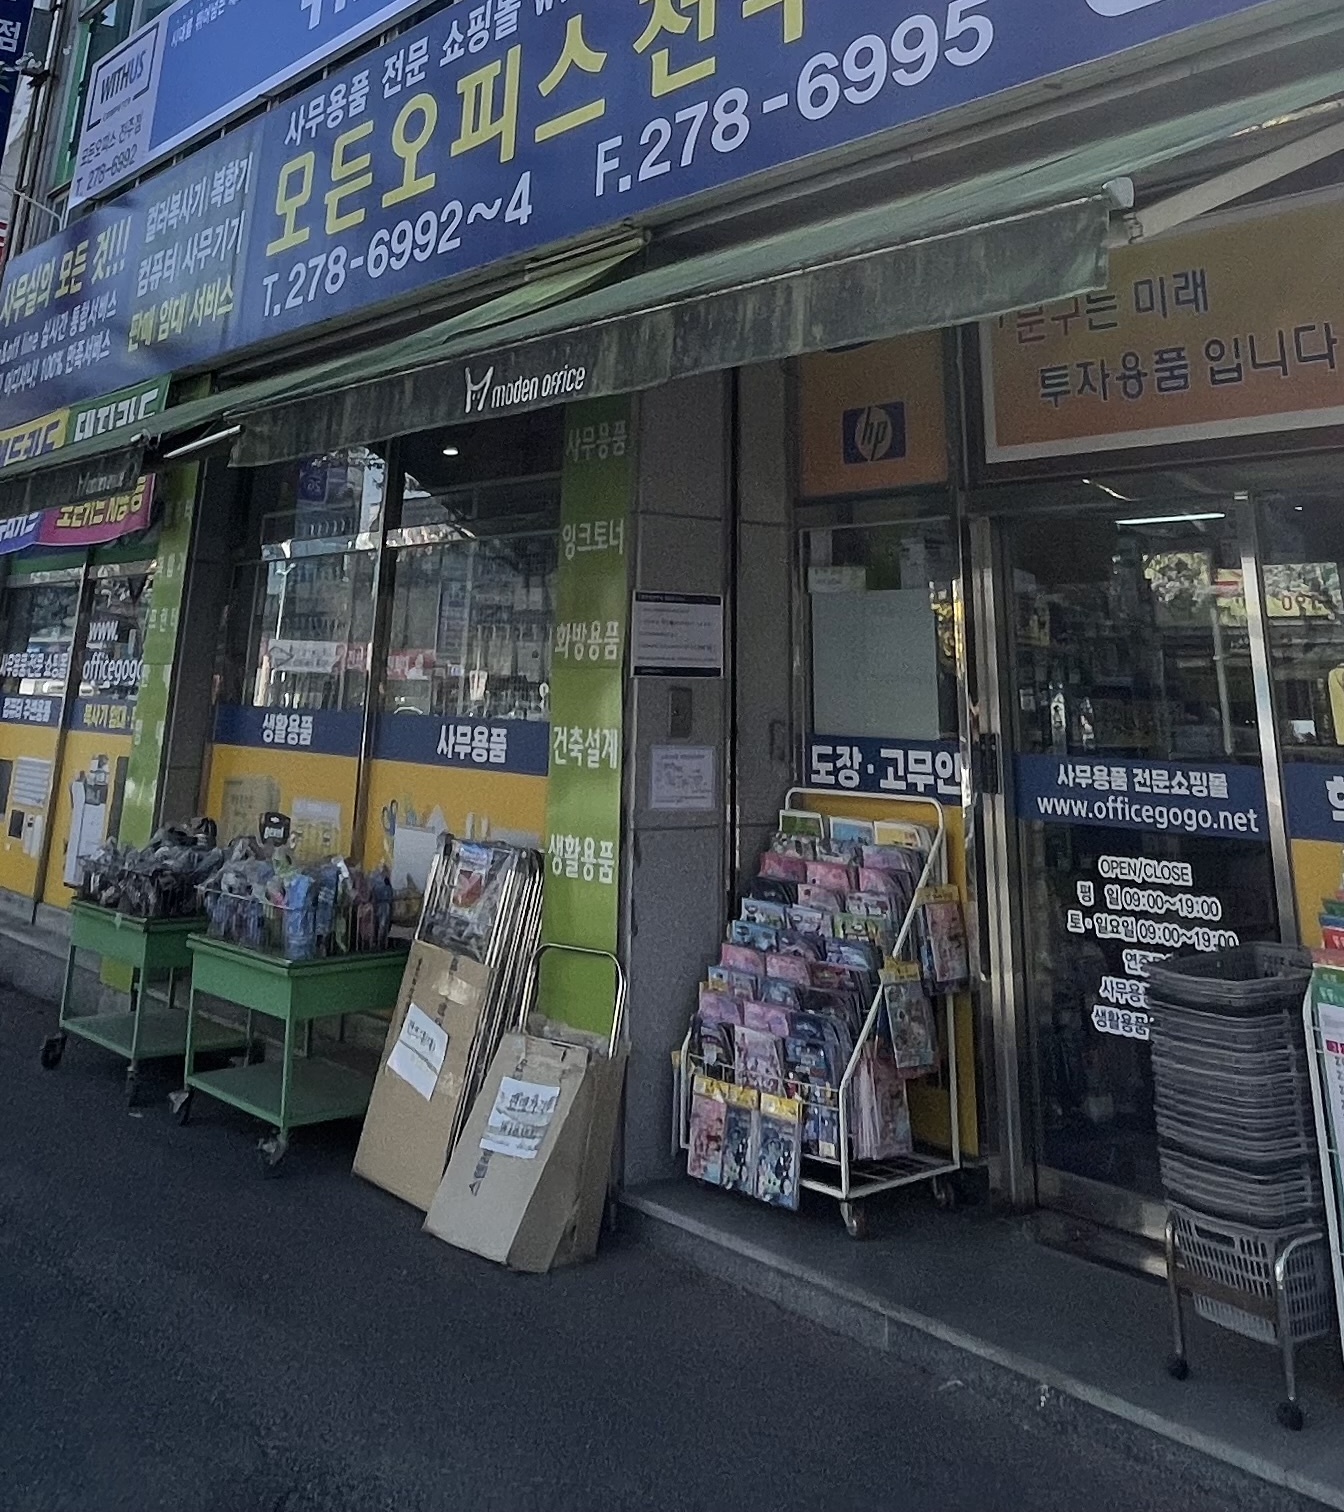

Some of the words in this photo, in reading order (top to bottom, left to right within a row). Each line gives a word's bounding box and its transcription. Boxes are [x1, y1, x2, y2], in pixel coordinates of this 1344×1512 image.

[99, 49, 147, 105] WITHUS
[282, 68, 374, 149] 사무용품
[380, 34, 430, 102] 전문
[210, 151, 254, 209] 복합기
[136, 241, 179, 298] 컴퓨터
[181, 209, 247, 275] 사무기기
[0, 256, 56, 328] 사무실의
[54, 239, 89, 299] 모든
[188, 274, 235, 328] 서비스
[1132, 267, 1209, 319] 미래
[490, 375, 539, 410] moden
[540, 364, 586, 399] office
[1039, 345, 1192, 408] 투자용품
[565, 421, 629, 459] 사무용품
[561, 517, 626, 561] 잉크토너
[553, 620, 620, 664] 화방용품
[261, 712, 314, 747] 생활용품
[436, 724, 508, 765] 사무용품
[552, 726, 619, 771] 건축설계
[1056, 763, 1129, 793] 사무용품
[1131, 767, 1229, 800] 전문쇼핑몰
[1036, 793, 1260, 835] www.officegogo.net
[547, 833, 616, 885] 생활용품
[1099, 856, 1192, 885] OPEN/CLOSE
